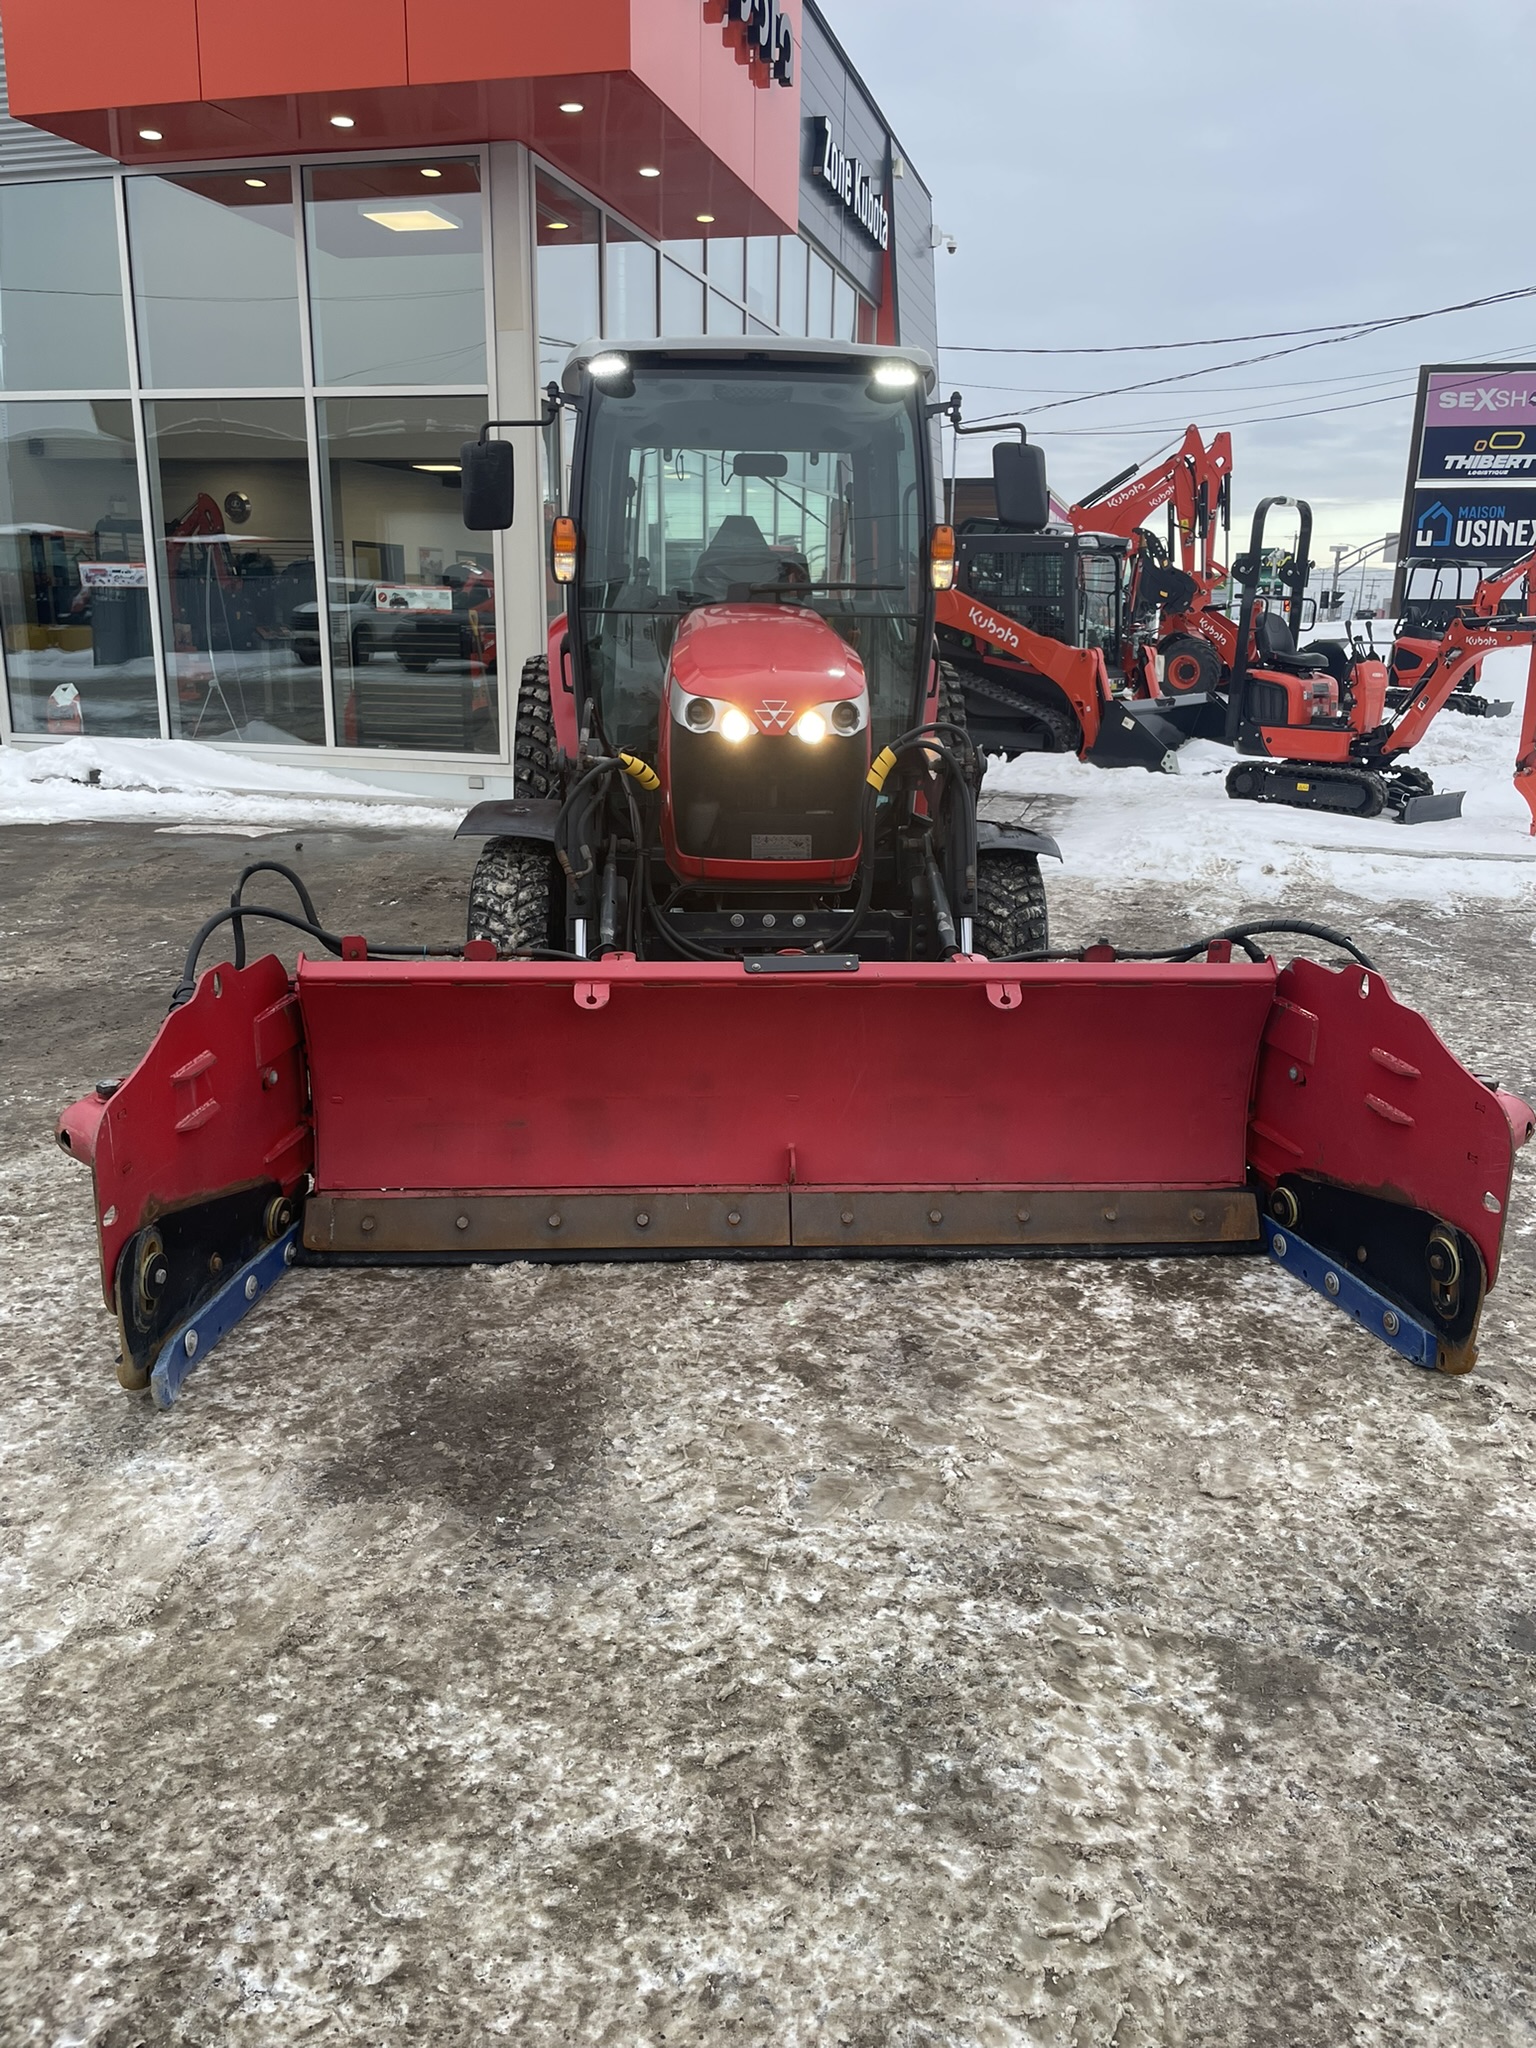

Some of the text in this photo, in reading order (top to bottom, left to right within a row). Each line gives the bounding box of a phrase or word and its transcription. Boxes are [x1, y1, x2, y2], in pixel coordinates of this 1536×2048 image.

[823, 116, 888, 250] Zone Kubota
[1438, 388, 1536, 412] SEXSH
[1444, 454, 1536, 470] THIBERT
[1106, 482, 1146, 508] Kubota
[1148, 485, 1175, 507] Kubot
[1458, 505, 1506, 519] MAISON
[968, 606, 1019, 648] Kubota
[1199, 617, 1227, 646] Kubota
[1465, 636, 1498, 646] Kubota
